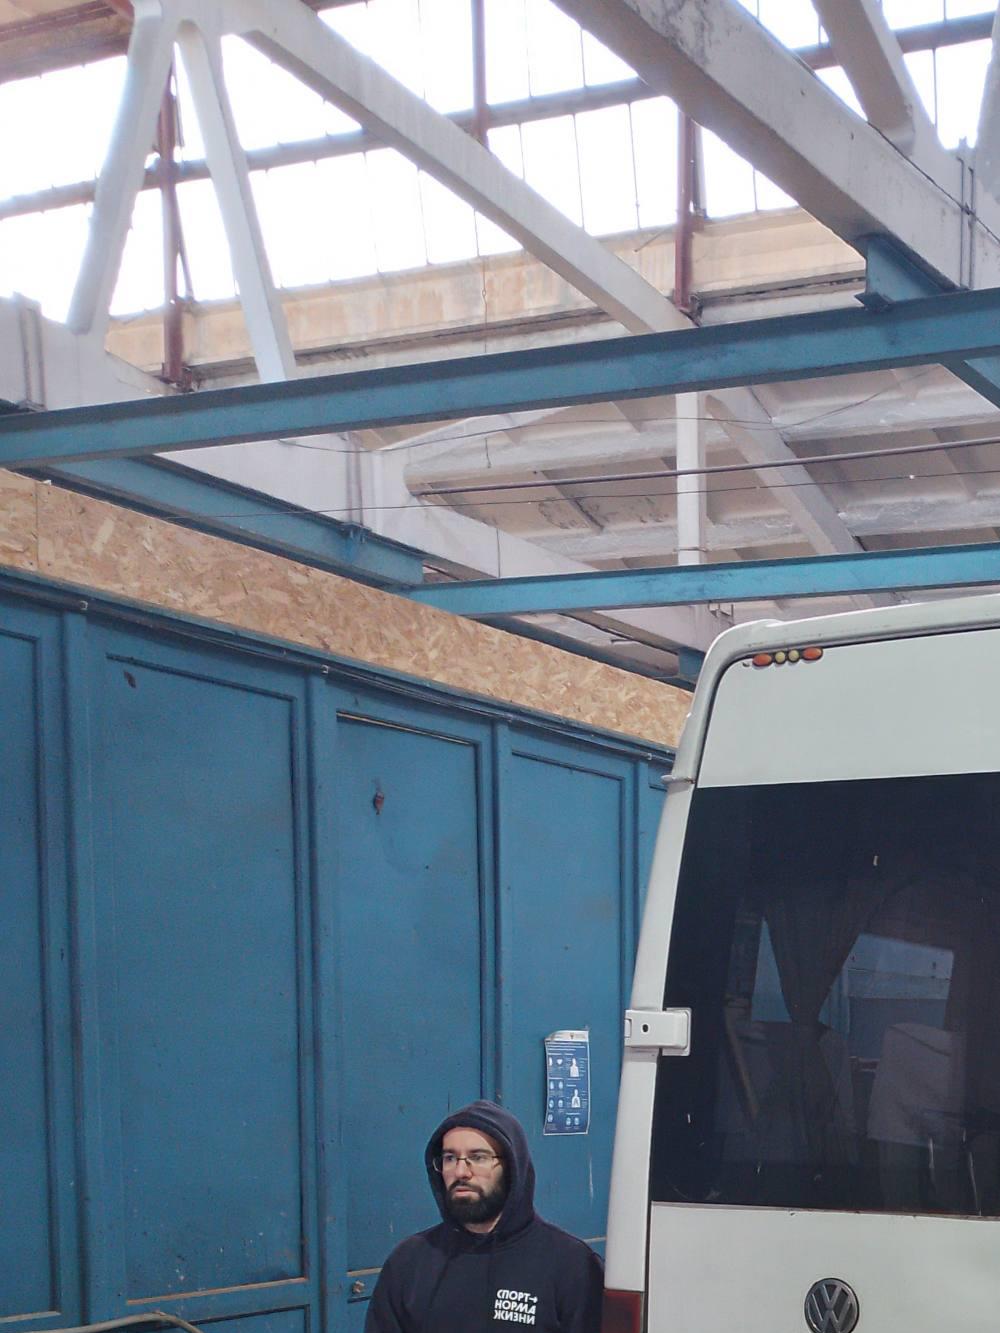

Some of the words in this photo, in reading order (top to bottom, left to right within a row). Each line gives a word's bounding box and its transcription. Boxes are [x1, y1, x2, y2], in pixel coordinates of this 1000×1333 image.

[496, 1289, 531, 1303] СПОРТ
[494, 1299, 537, 1315] НОРМА
[493, 1309, 537, 1325] ЖИЗНИ
